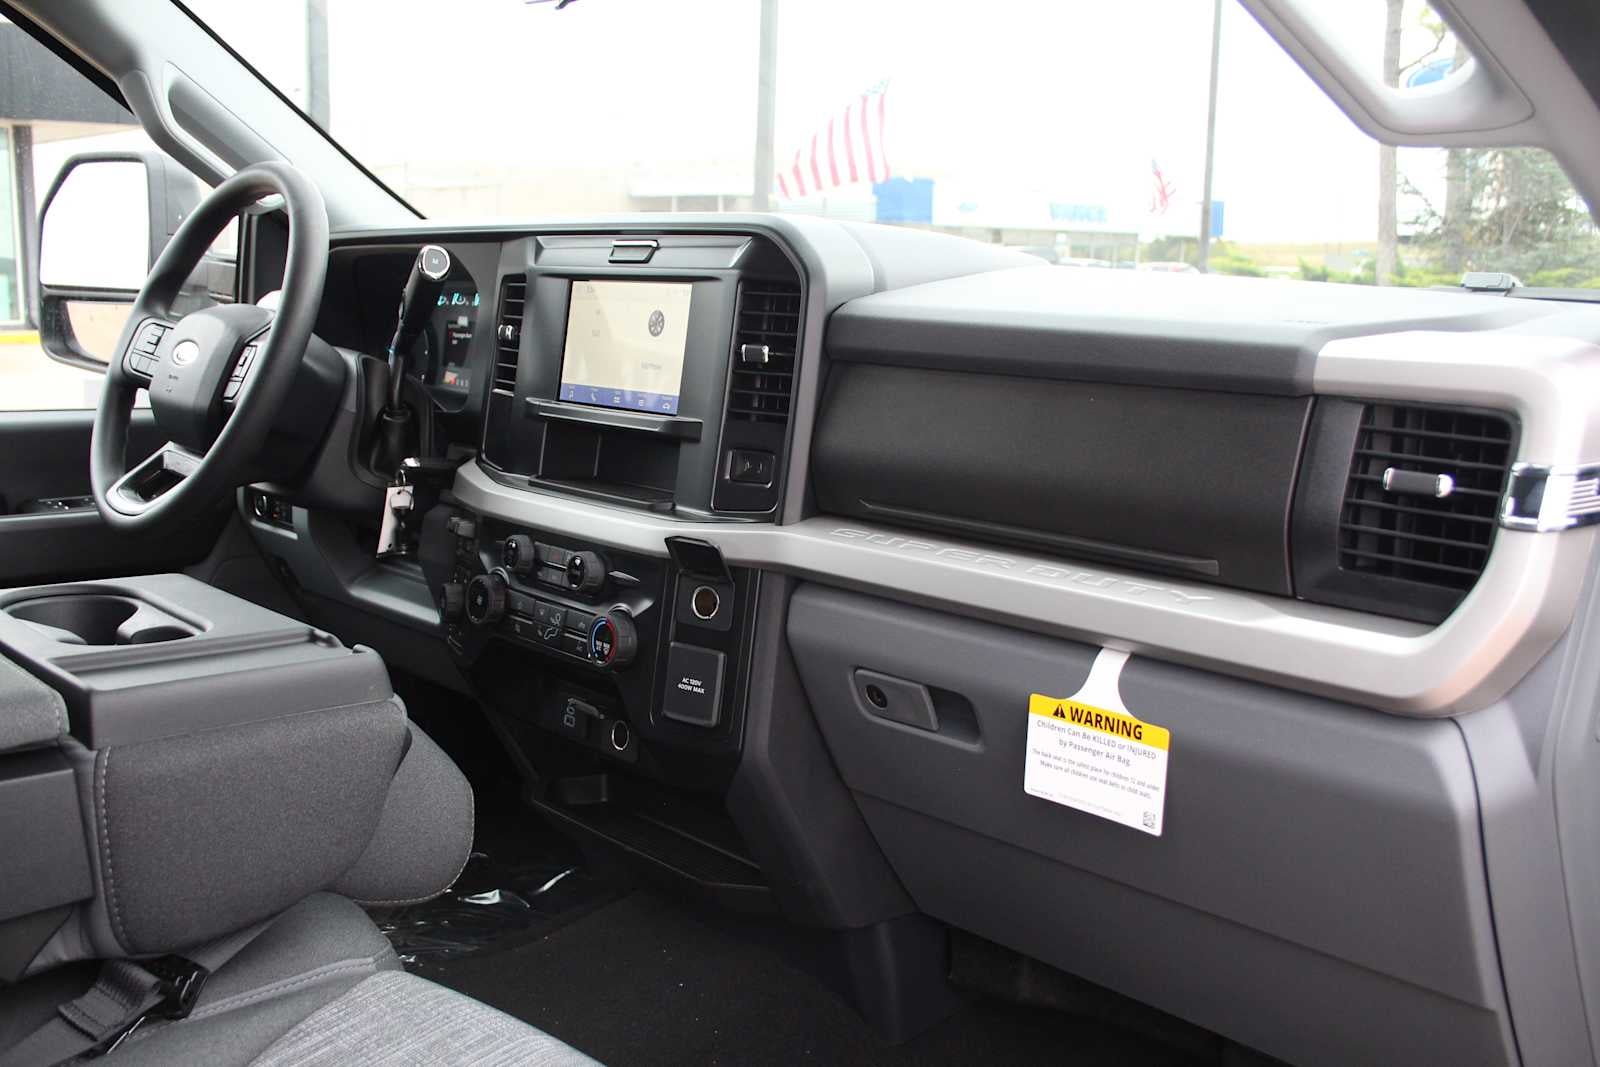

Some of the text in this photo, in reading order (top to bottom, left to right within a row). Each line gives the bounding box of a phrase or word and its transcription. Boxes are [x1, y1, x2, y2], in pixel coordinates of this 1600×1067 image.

[830, 528, 1215, 605] SUPER DUTY
[678, 683, 704, 694] 400W MAX
[1037, 720, 1066, 733] Children
[1067, 728, 1080, 737] Can
[1082, 732, 1091, 740] Be
[1092, 735, 1116, 748] KILLED
[1128, 745, 1156, 760] INJURED
[1070, 706, 1142, 740] WARNING
[1059, 739, 1067, 748] by
[1069, 741, 1104, 757] Passenger
[1106, 752, 1115, 760] Air
